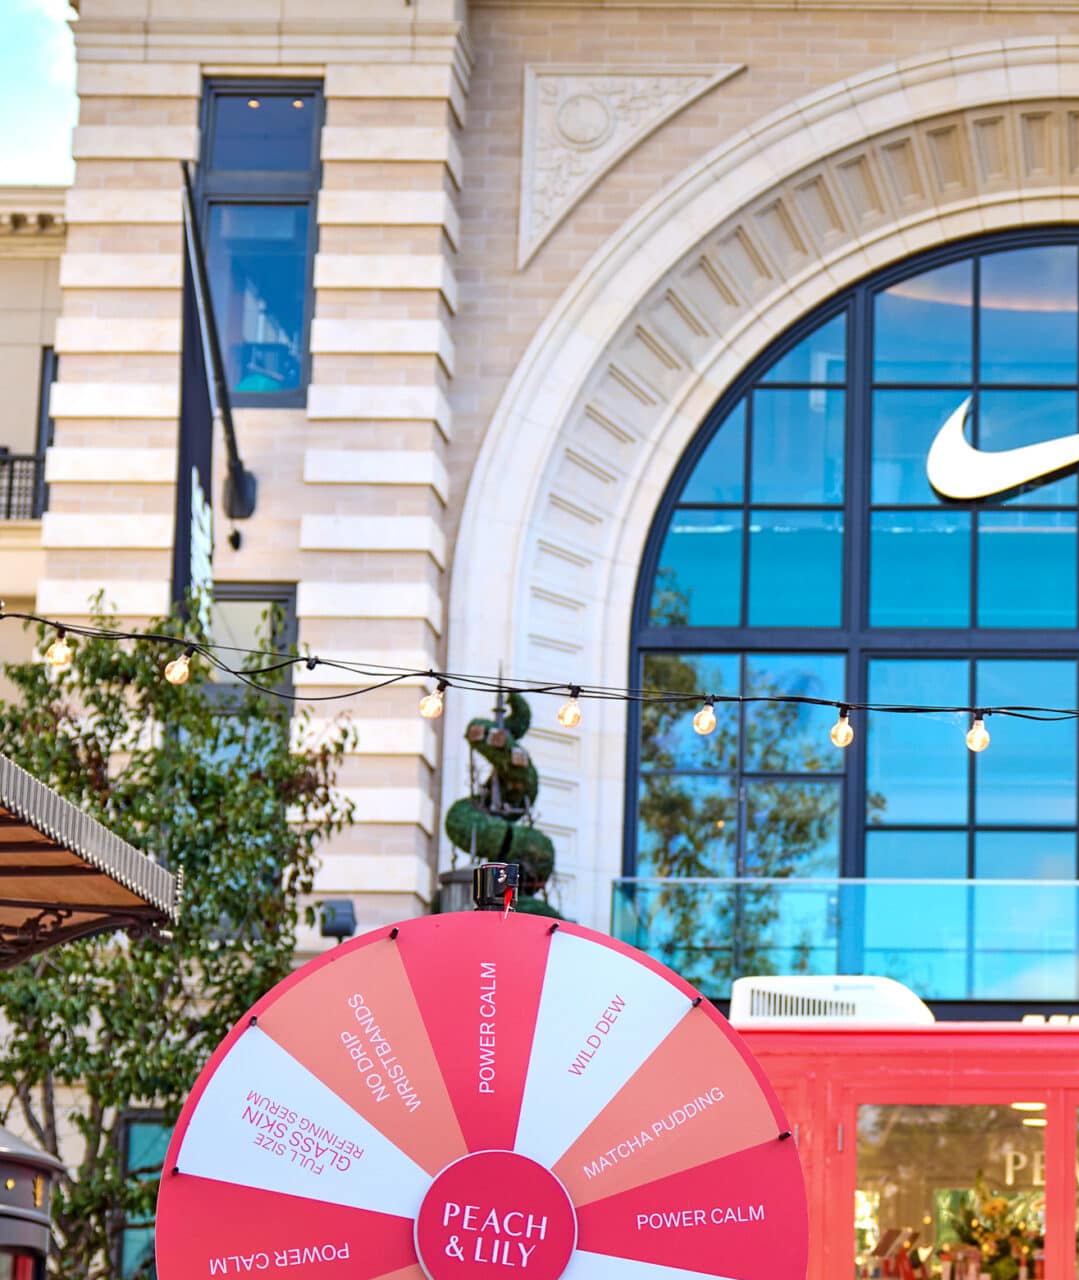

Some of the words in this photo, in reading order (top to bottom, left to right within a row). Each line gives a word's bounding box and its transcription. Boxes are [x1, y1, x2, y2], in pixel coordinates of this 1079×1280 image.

[479, 962, 497, 1018] CALM
[340, 1031, 374, 1073] DRIP
[567, 1034, 602, 1076] WILD
[595, 994, 626, 1035] DEW
[479, 1022, 496, 1093] POWER
[366, 1073, 390, 1102] NO
[242, 1105, 288, 1139] SKIN
[246, 1089, 298, 1124] SERUM
[253, 1132, 287, 1156] SIZE
[298, 1117, 364, 1160] REFINING
[583, 1131, 653, 1180] MATCHA
[651, 1087, 725, 1137] PUDDING
[288, 1131, 351, 1172] GLASS
[290, 1149, 325, 1175] FULL
[443, 1202, 548, 1240] PEACH
[636, 1210, 707, 1231] POWER
[711, 1205, 765, 1224] CALM
[209, 1252, 270, 1275] CALM
[275, 1242, 350, 1267] POWER
[445, 1235, 464, 1261] &
[474, 1237, 536, 1268] LILY
